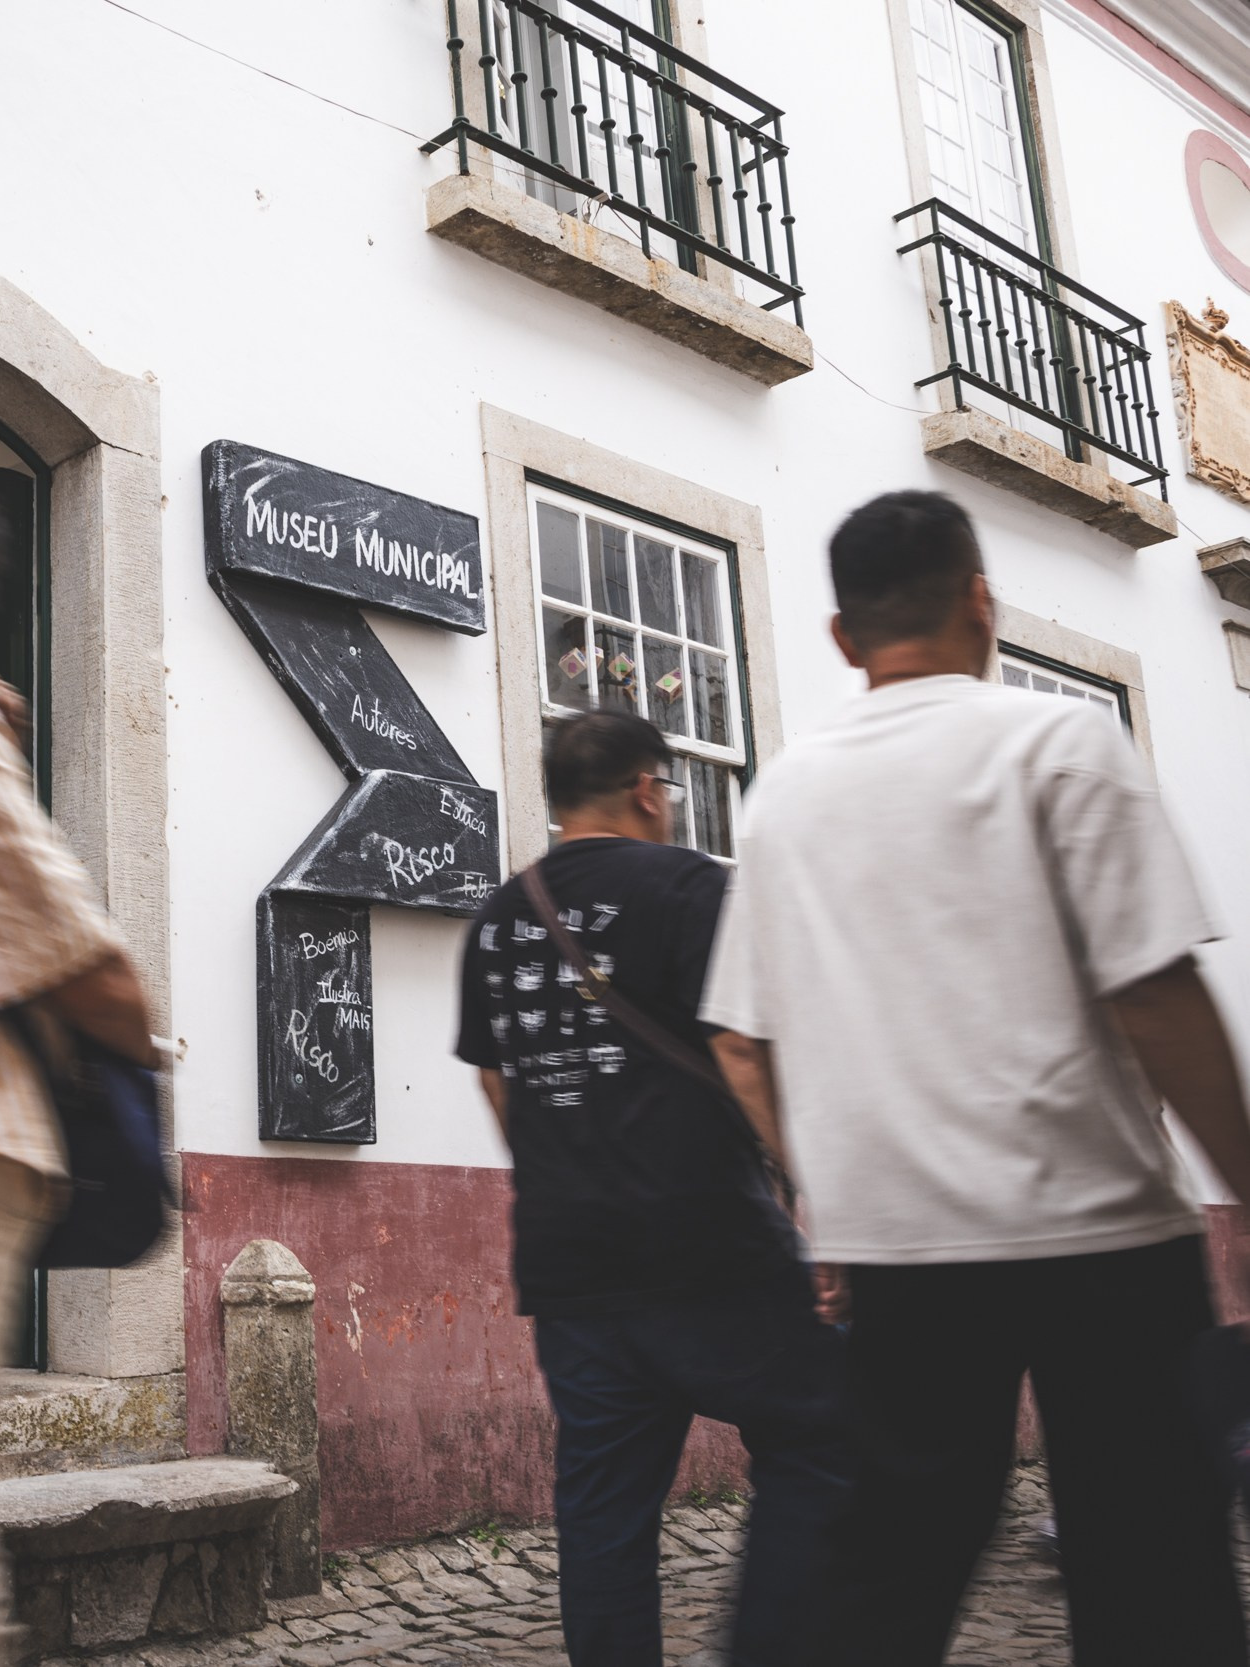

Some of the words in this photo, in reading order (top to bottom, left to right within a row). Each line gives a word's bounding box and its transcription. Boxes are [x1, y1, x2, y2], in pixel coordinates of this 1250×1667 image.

[246, 495, 339, 559] MUSEU
[355, 527, 479, 600] MUNICIPAL
[351, 693, 417, 750] Autores
